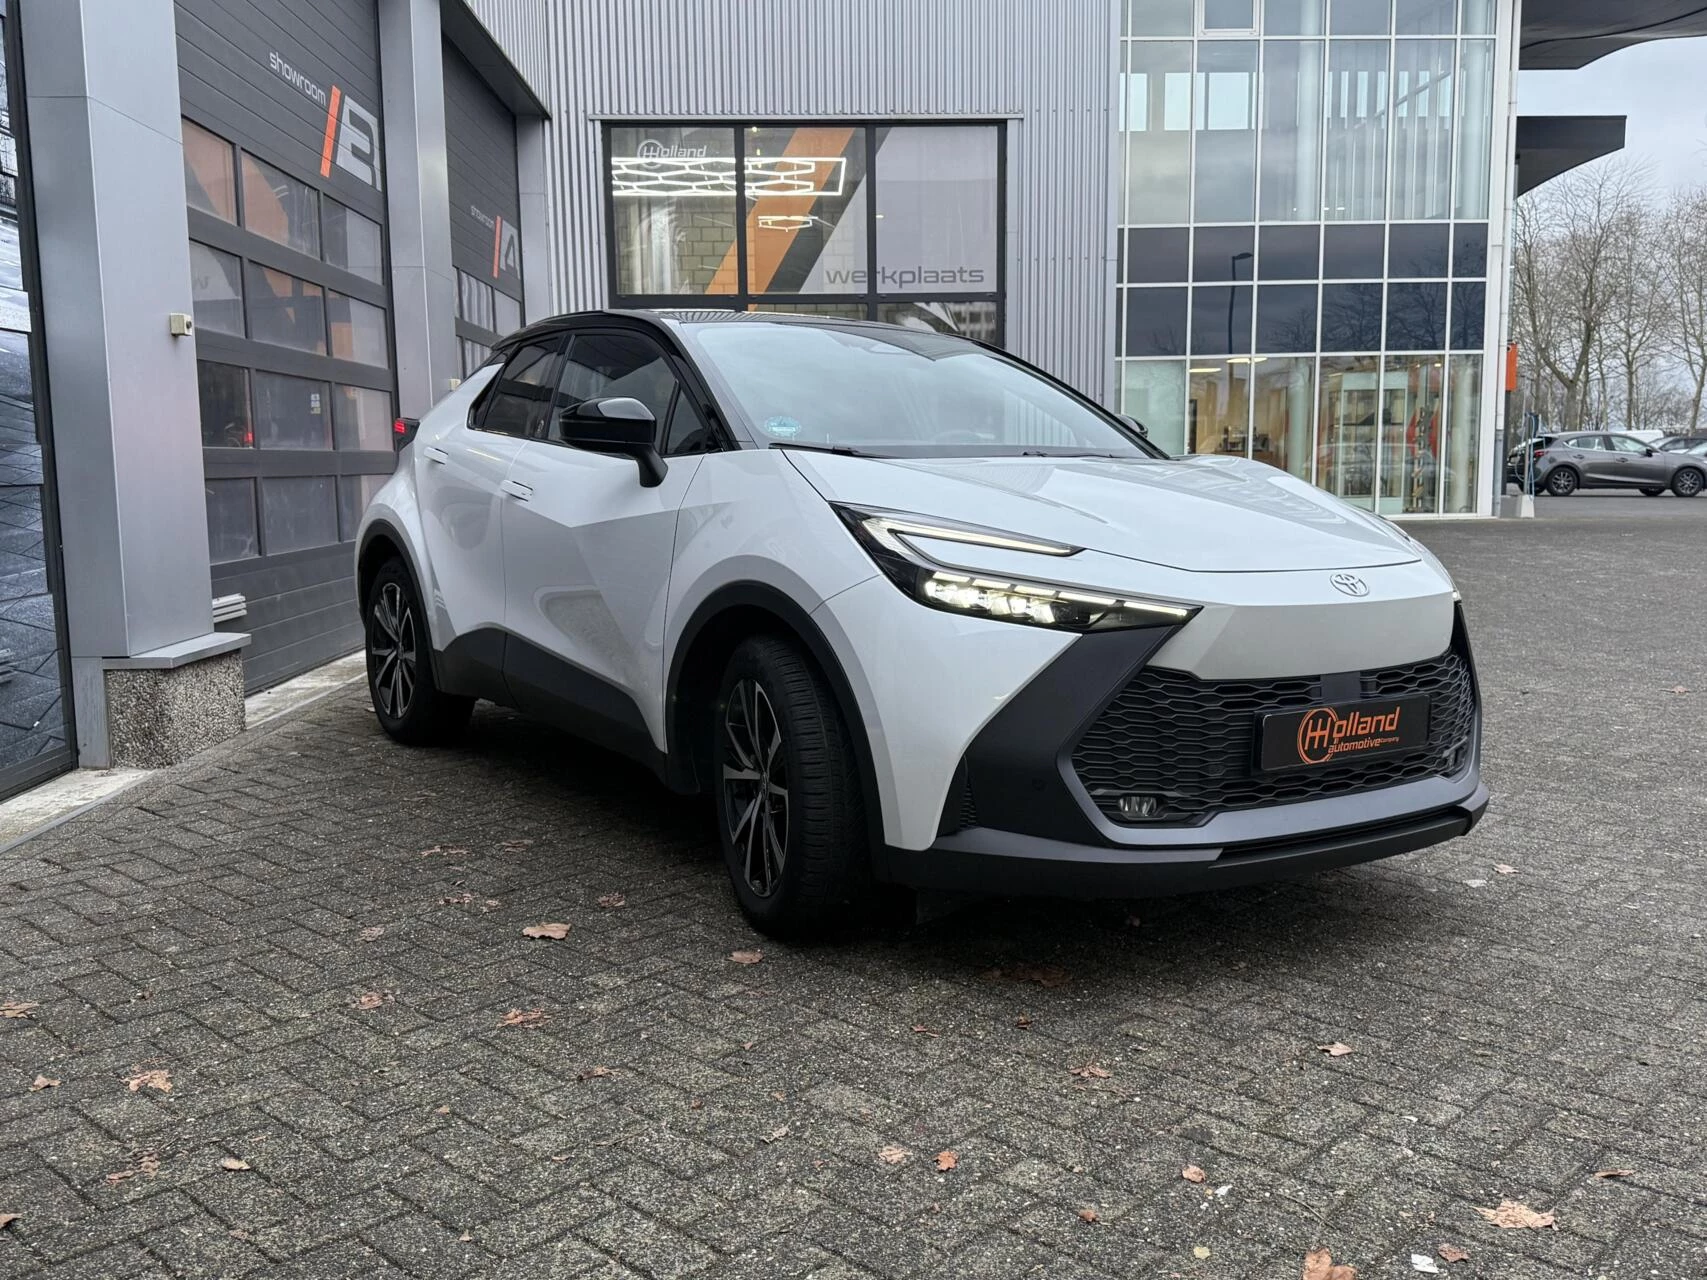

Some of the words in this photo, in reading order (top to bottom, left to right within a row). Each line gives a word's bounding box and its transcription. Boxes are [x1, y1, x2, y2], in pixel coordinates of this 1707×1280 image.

[269, 51, 327, 106] showroom
[637, 139, 707, 160] Holland
[500, 219, 520, 280] A
[825, 265, 985, 289] wekplaats
[1298, 706, 1400, 759] Holland
[1328, 736, 1381, 754] automotive
